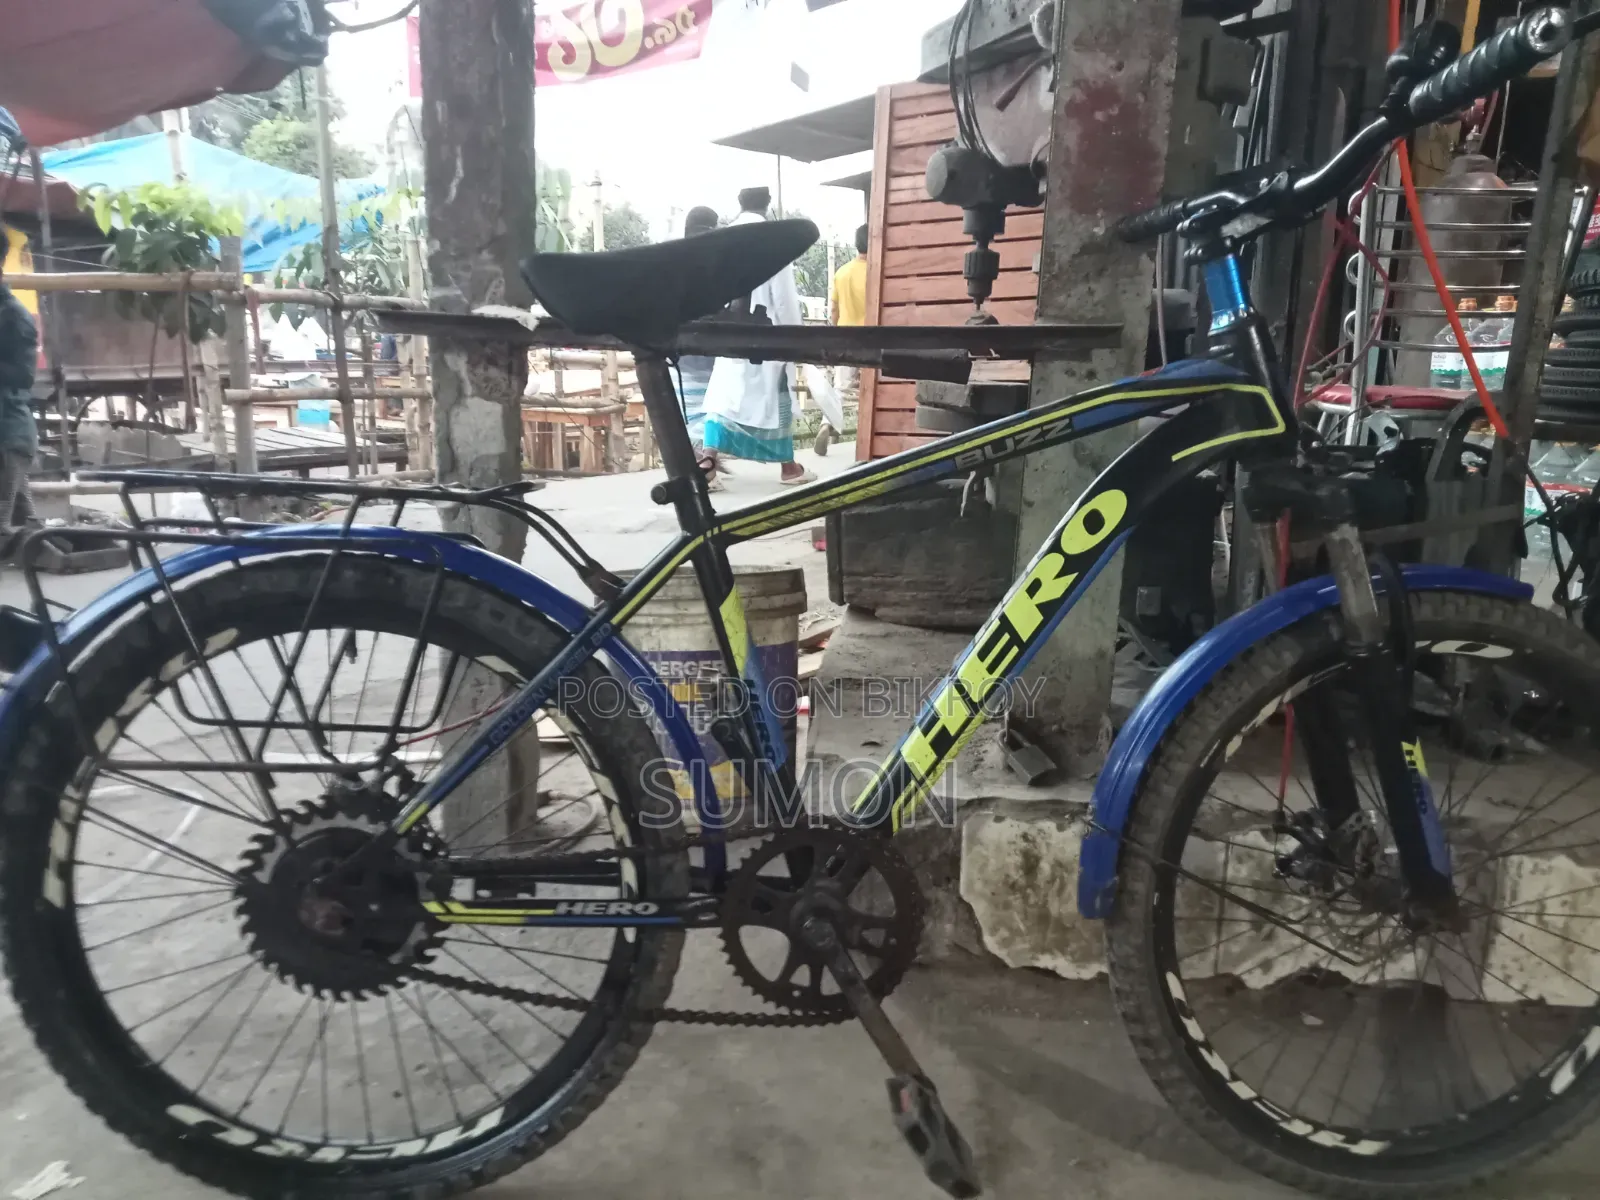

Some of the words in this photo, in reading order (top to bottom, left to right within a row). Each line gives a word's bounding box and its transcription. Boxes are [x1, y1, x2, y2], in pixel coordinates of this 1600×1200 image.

[955, 418, 1073, 471] BUZZ
[901, 489, 1128, 771] HERO
[554, 901, 659, 915] HERO
